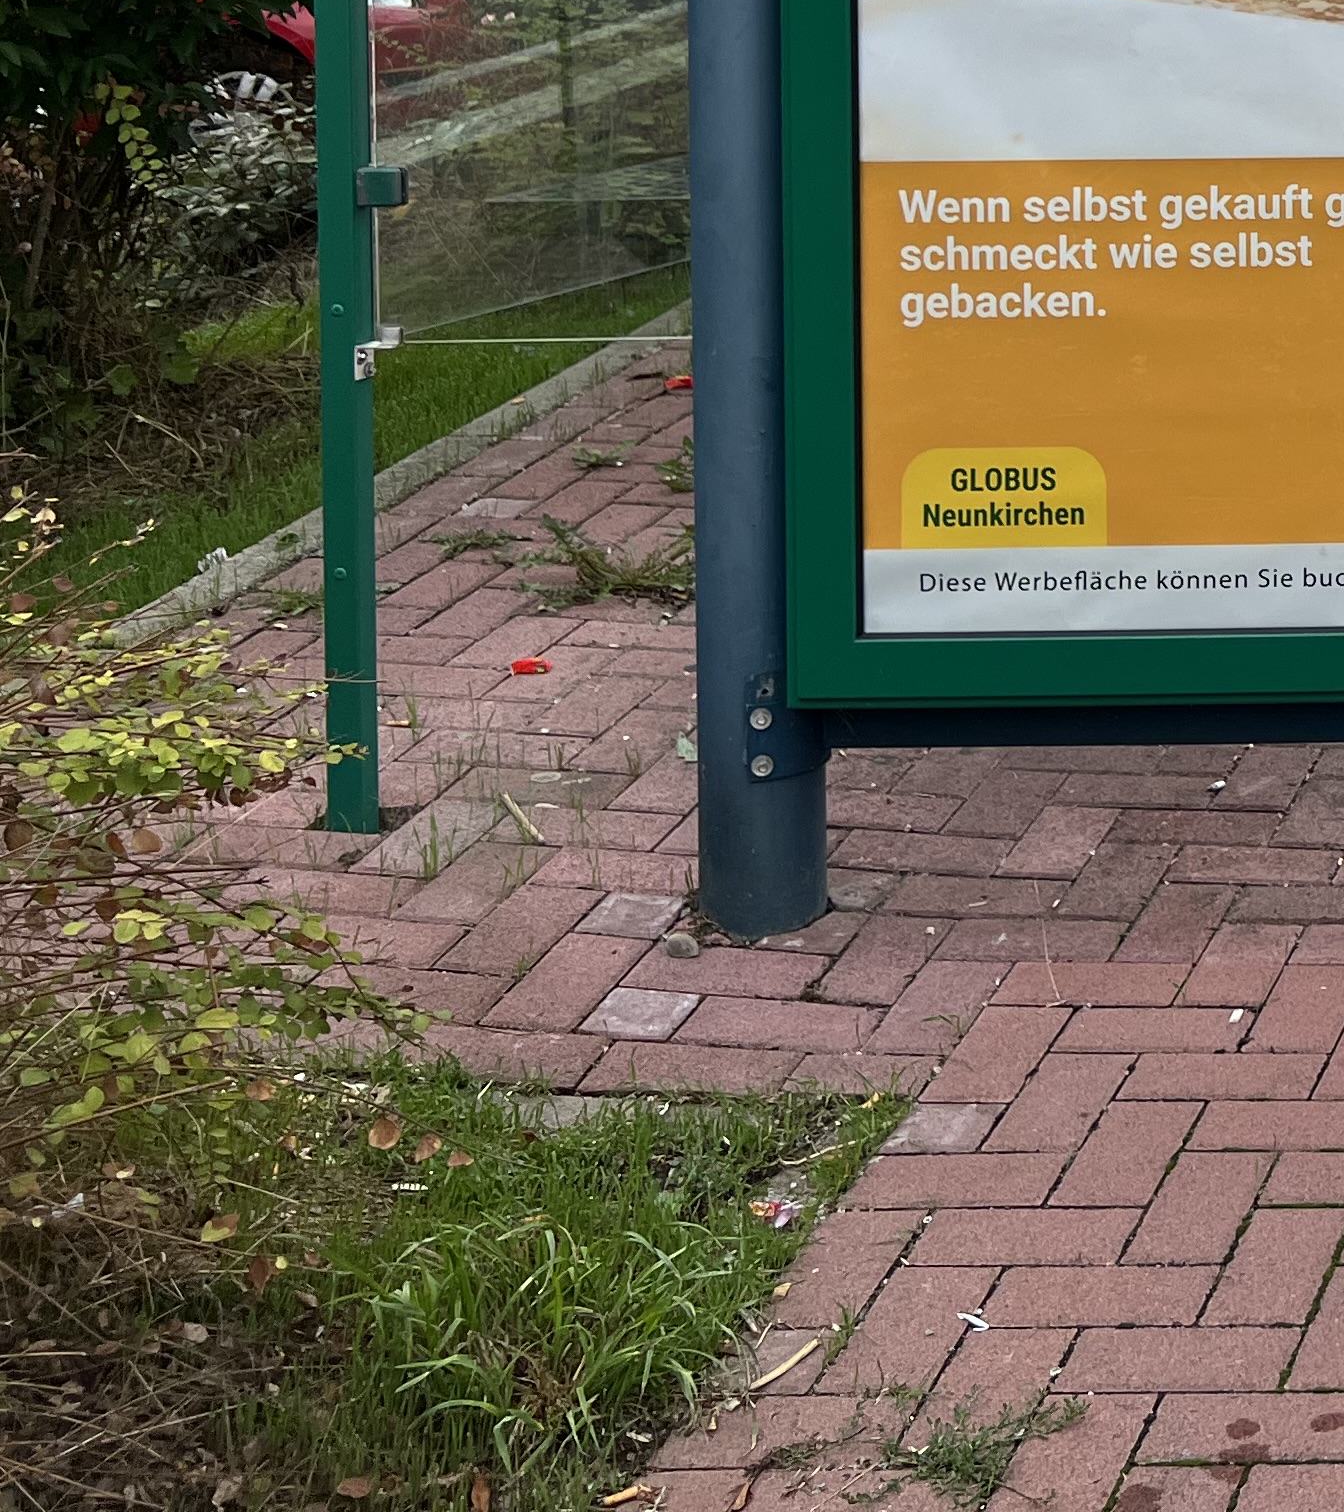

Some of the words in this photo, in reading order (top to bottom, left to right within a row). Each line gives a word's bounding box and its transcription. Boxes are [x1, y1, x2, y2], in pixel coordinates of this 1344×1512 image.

[899, 189, 1011, 224] Wenn
[1023, 186, 1148, 223] selbst
[1159, 183, 1313, 230] gekauft
[900, 234, 1098, 272] schmeckt
[1108, 233, 1178, 269] wie
[1189, 231, 1313, 268] selbst
[900, 282, 1107, 328] gebacken.
[950, 466, 1057, 492] GLOBUS
[922, 501, 1085, 528] Neunkirchen
[919, 573, 986, 593] Diese
[994, 569, 1148, 592] Werbefläche
[1157, 569, 1248, 590] können
[1258, 568, 1294, 588] Sie
